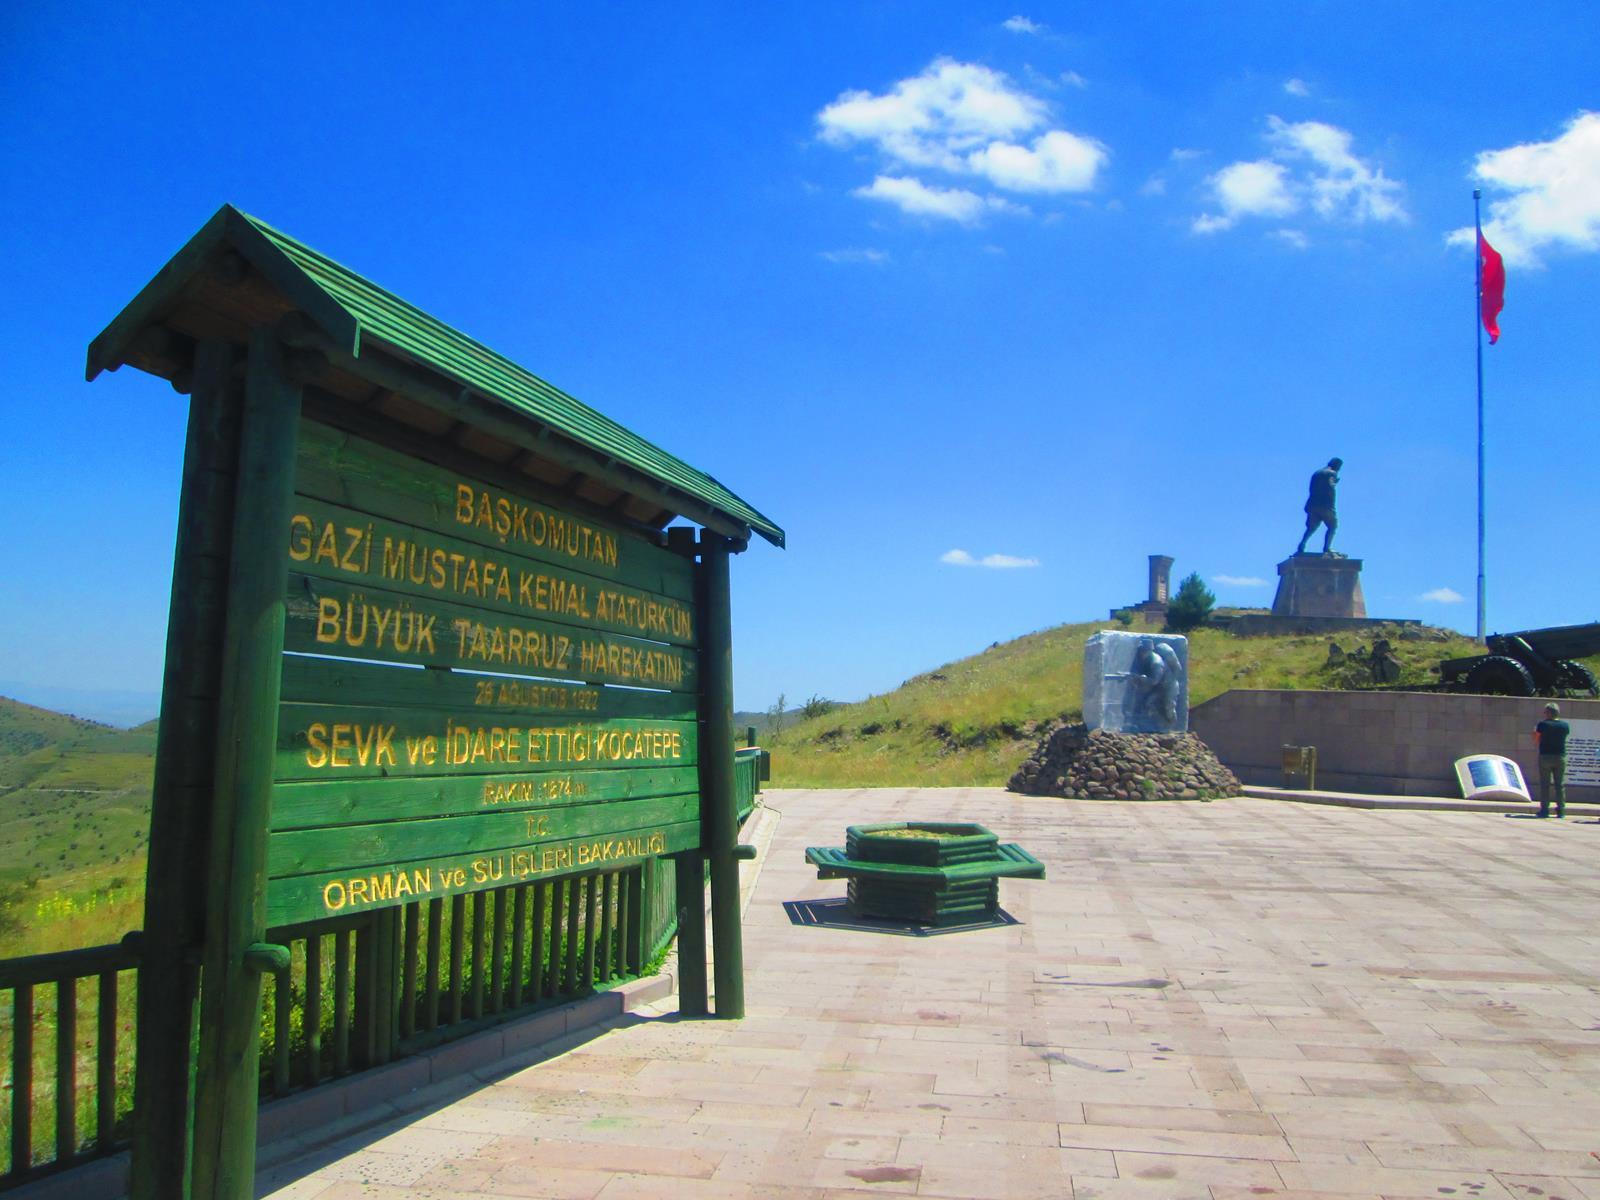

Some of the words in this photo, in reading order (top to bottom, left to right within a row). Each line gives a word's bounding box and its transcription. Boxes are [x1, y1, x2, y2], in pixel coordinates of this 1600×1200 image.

[456, 484, 618, 567] BAŞKOMUTAN
[289, 514, 374, 574] GAZİ
[383, 536, 513, 603] MUSTAFA
[519, 570, 591, 619] KEMAL
[596, 589, 692, 641] ATATÜRK'ÜN
[316, 593, 437, 655] BÜYÜK
[455, 619, 570, 670] TAARRUZ
[580, 640, 683, 683] HAREKATINI
[475, 681, 494, 705] 26
[305, 722, 398, 768] SEVK
[405, 734, 438, 765] ve
[444, 718, 521, 765] İDARE
[596, 727, 681, 761] KOCATEPE
[526, 814, 552, 838] T.C.
[322, 866, 432, 910] ORMAN
[438, 868, 467, 889] ve
[471, 856, 504, 884] SU
[510, 842, 574, 881] İŞLERİ
[577, 831, 666, 866] BAKANLIĞI
